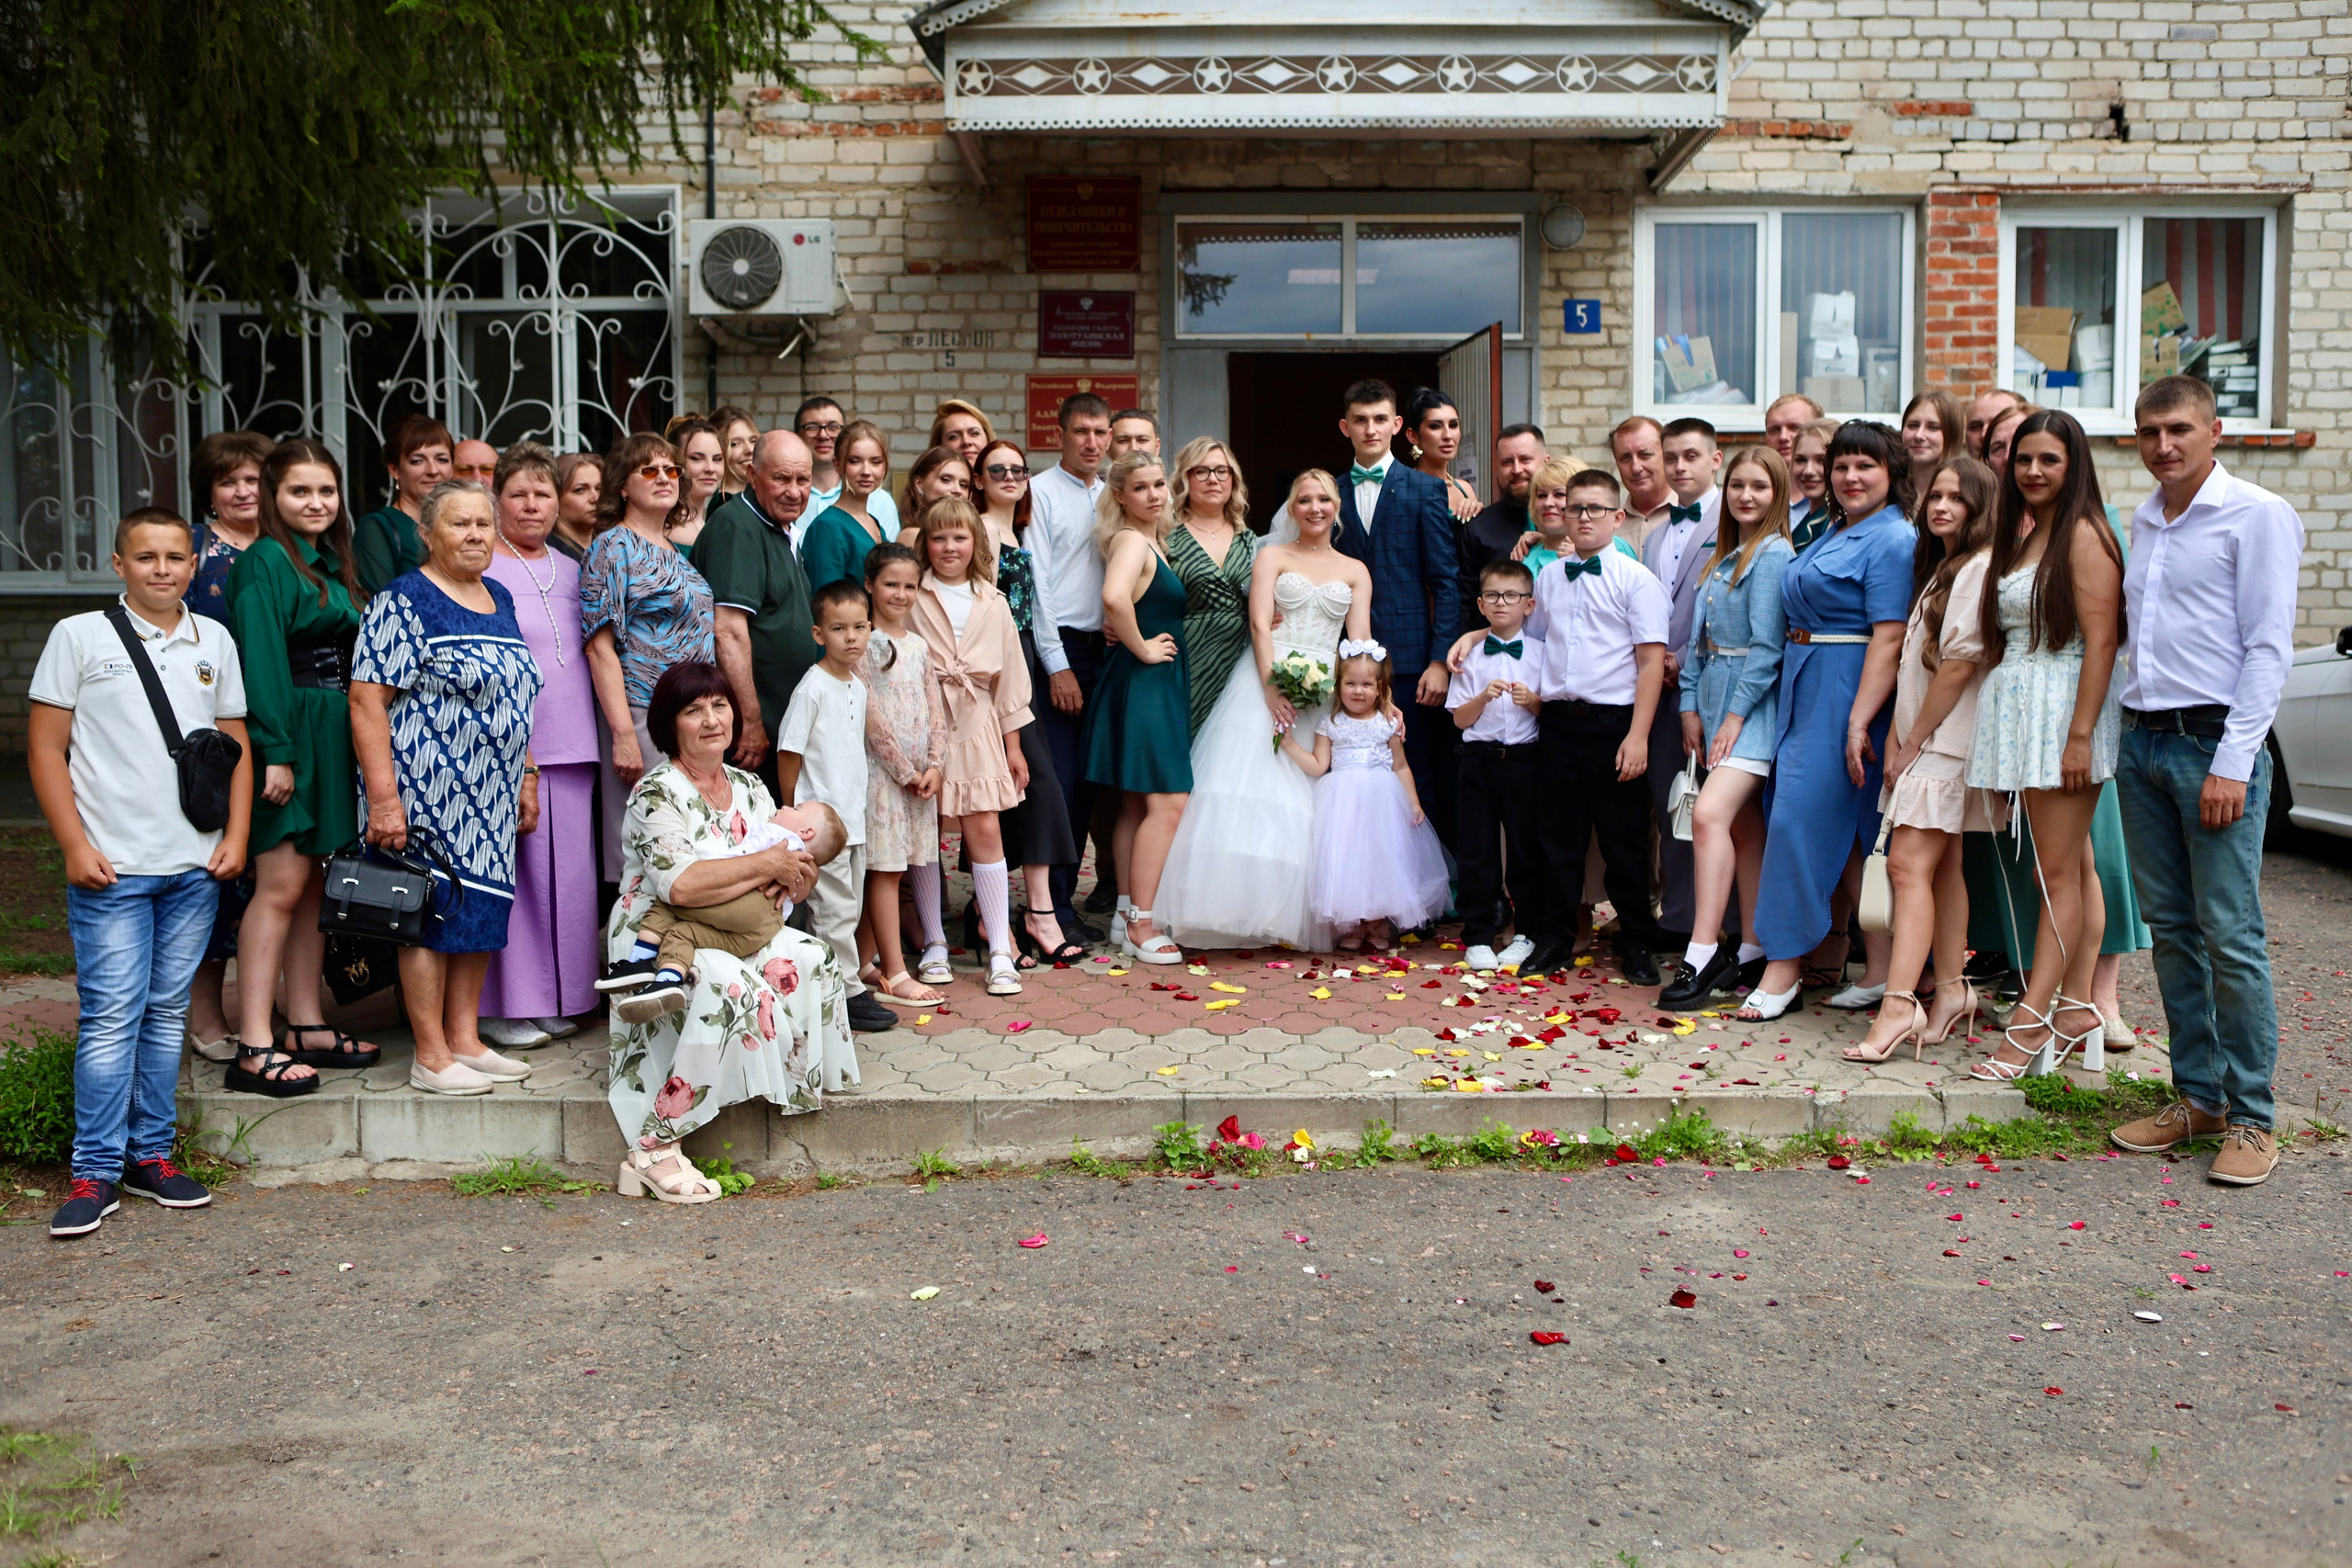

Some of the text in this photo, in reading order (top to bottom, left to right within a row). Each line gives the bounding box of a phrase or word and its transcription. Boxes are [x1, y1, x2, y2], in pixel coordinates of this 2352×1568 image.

[1040, 206, 1076, 218] ОТДЕЛ
[1078, 206, 1115, 218] ОПЕКИ
[1034, 221, 1134, 233] ПОПЕЧИТЕЛЬСТВА
[808, 235, 820, 243] LG
[1577, 304, 1588, 328] 5
[945, 349, 956, 367] 5
[1094, 382, 1136, 391] Федерация
